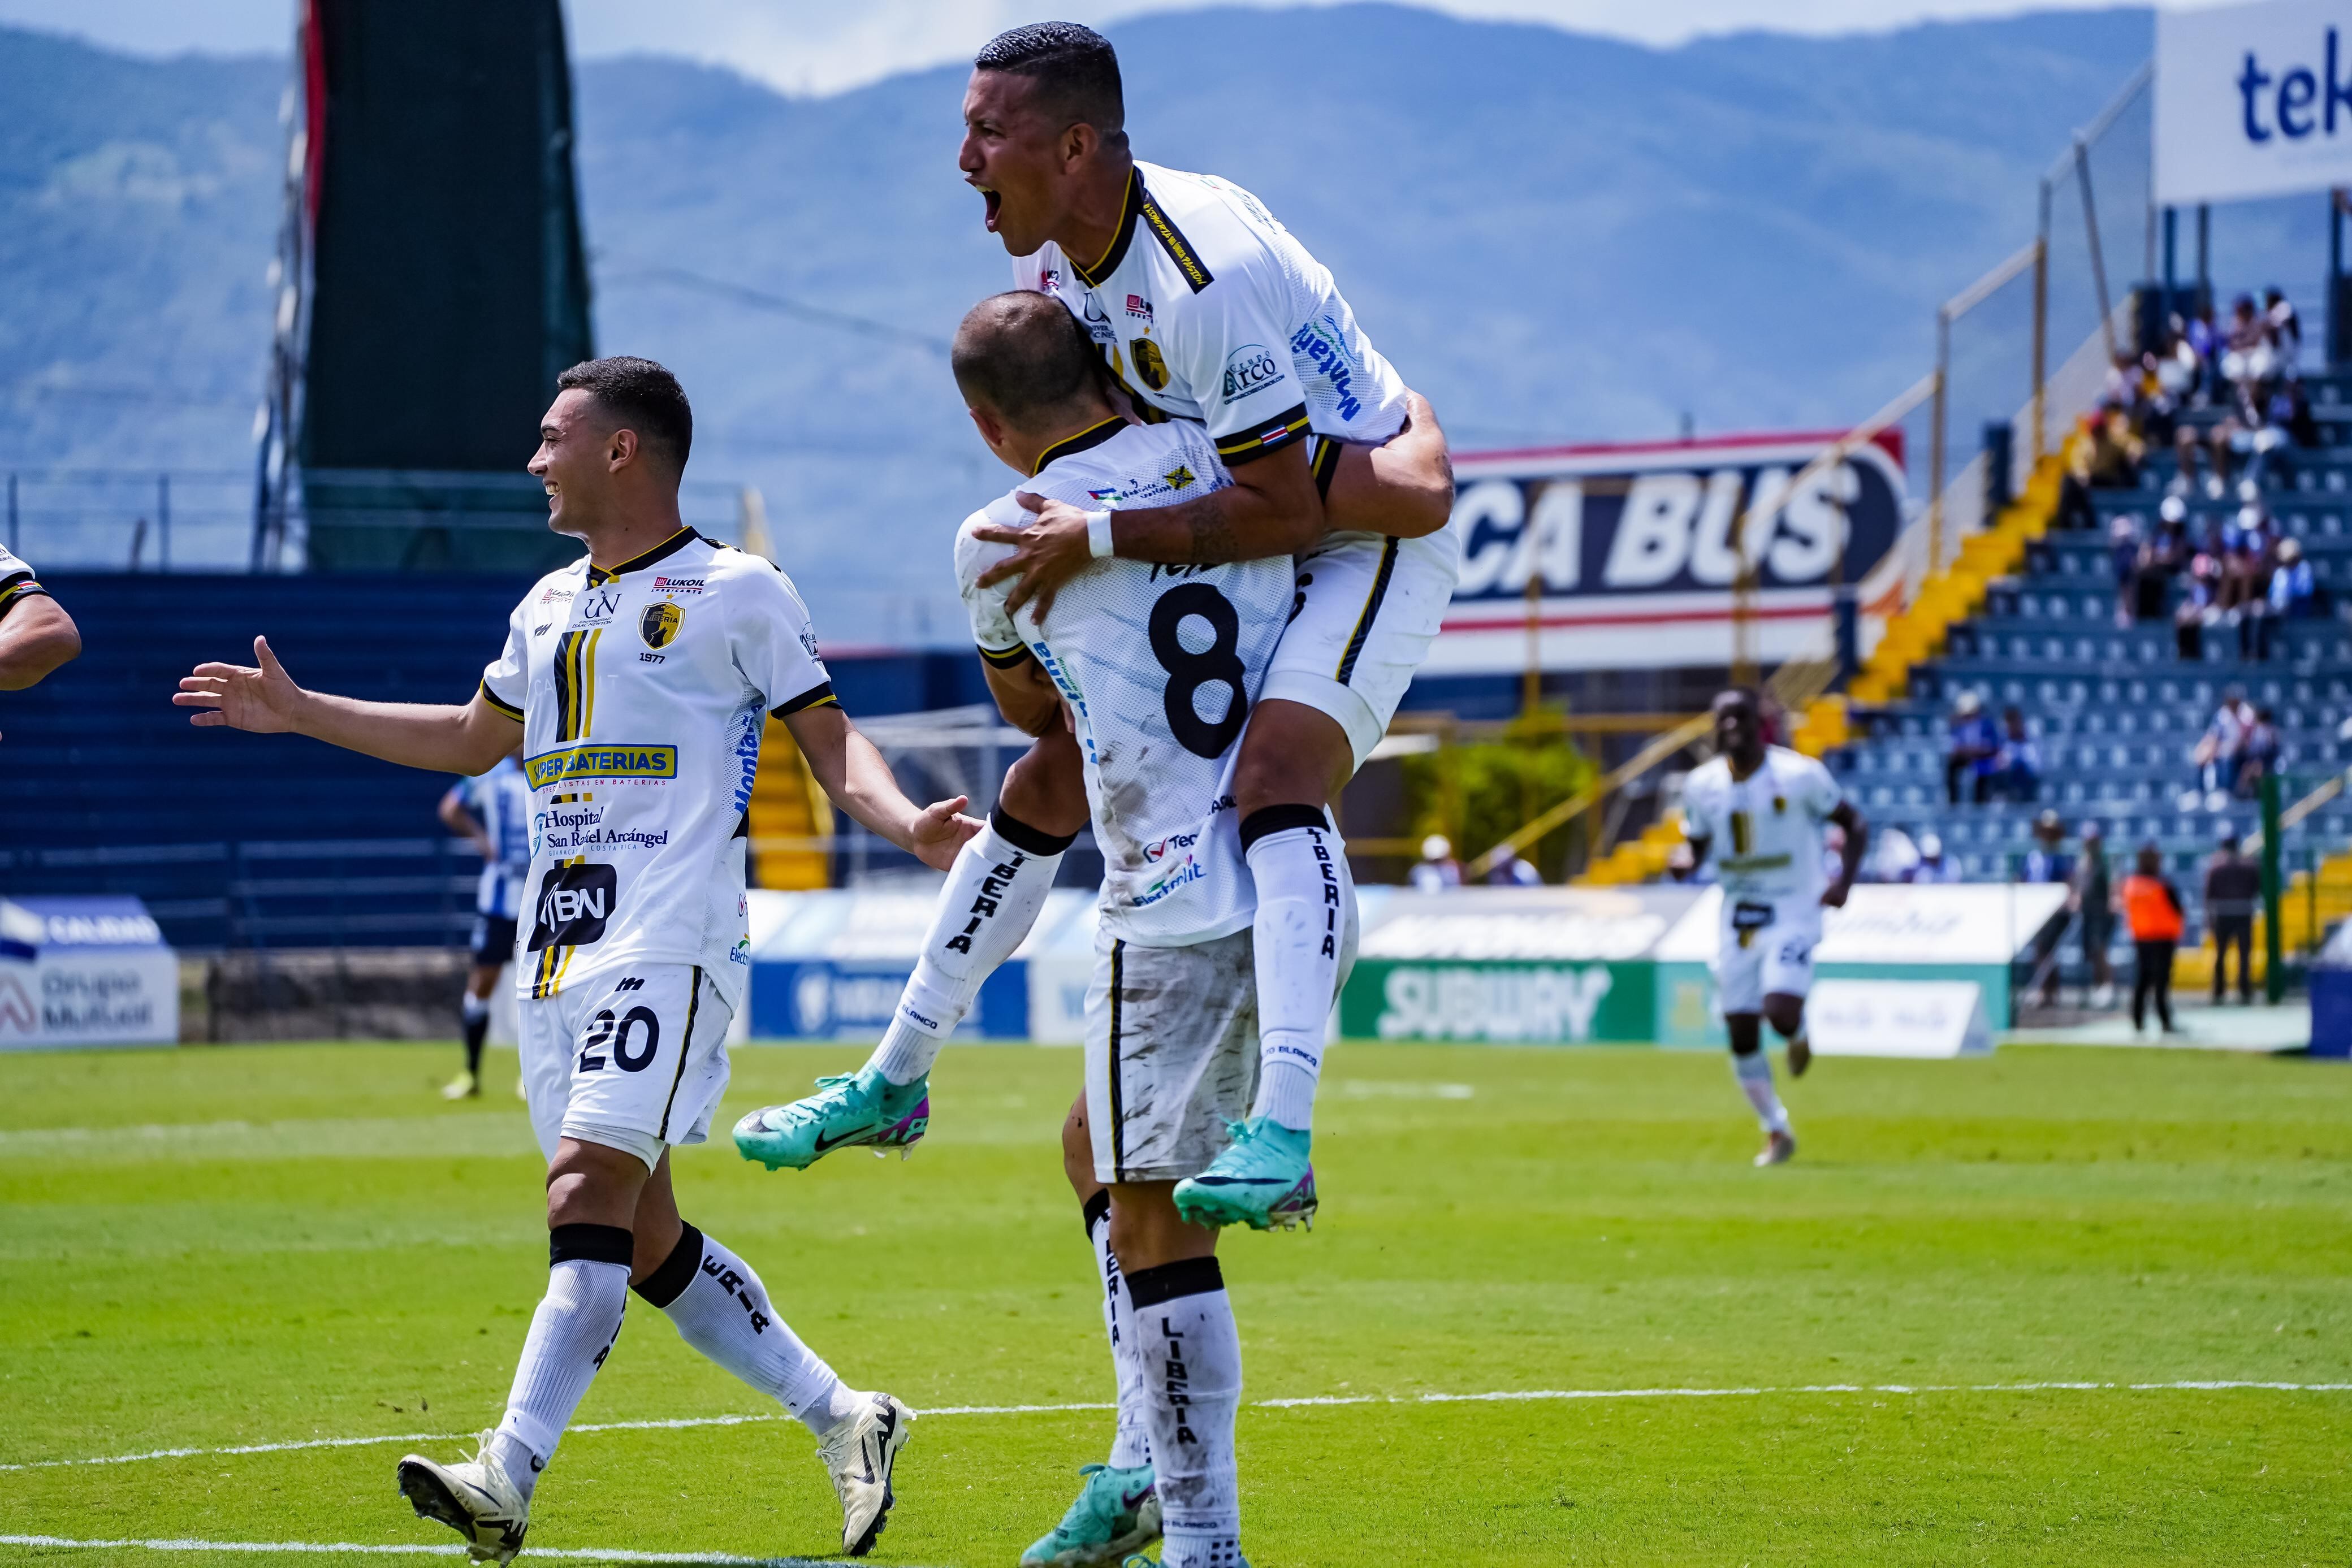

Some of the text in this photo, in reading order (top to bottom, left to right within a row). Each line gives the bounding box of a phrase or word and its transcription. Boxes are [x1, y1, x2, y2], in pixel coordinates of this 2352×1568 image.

[1229, 350, 1270, 374] Grupo
[1602, 461, 1861, 589] BUS
[645, 614, 678, 624] LIBERIA
[639, 652, 665, 664] 1977
[1148, 582, 1248, 759] 8
[565, 752, 667, 772] BATERIAS
[544, 805, 604, 831] Hospital
[547, 833, 568, 848] San
[606, 828, 668, 848] Arcángel
[579, 1006, 660, 1073] 20
[1161, 1316, 1199, 1445] LIBERIA
